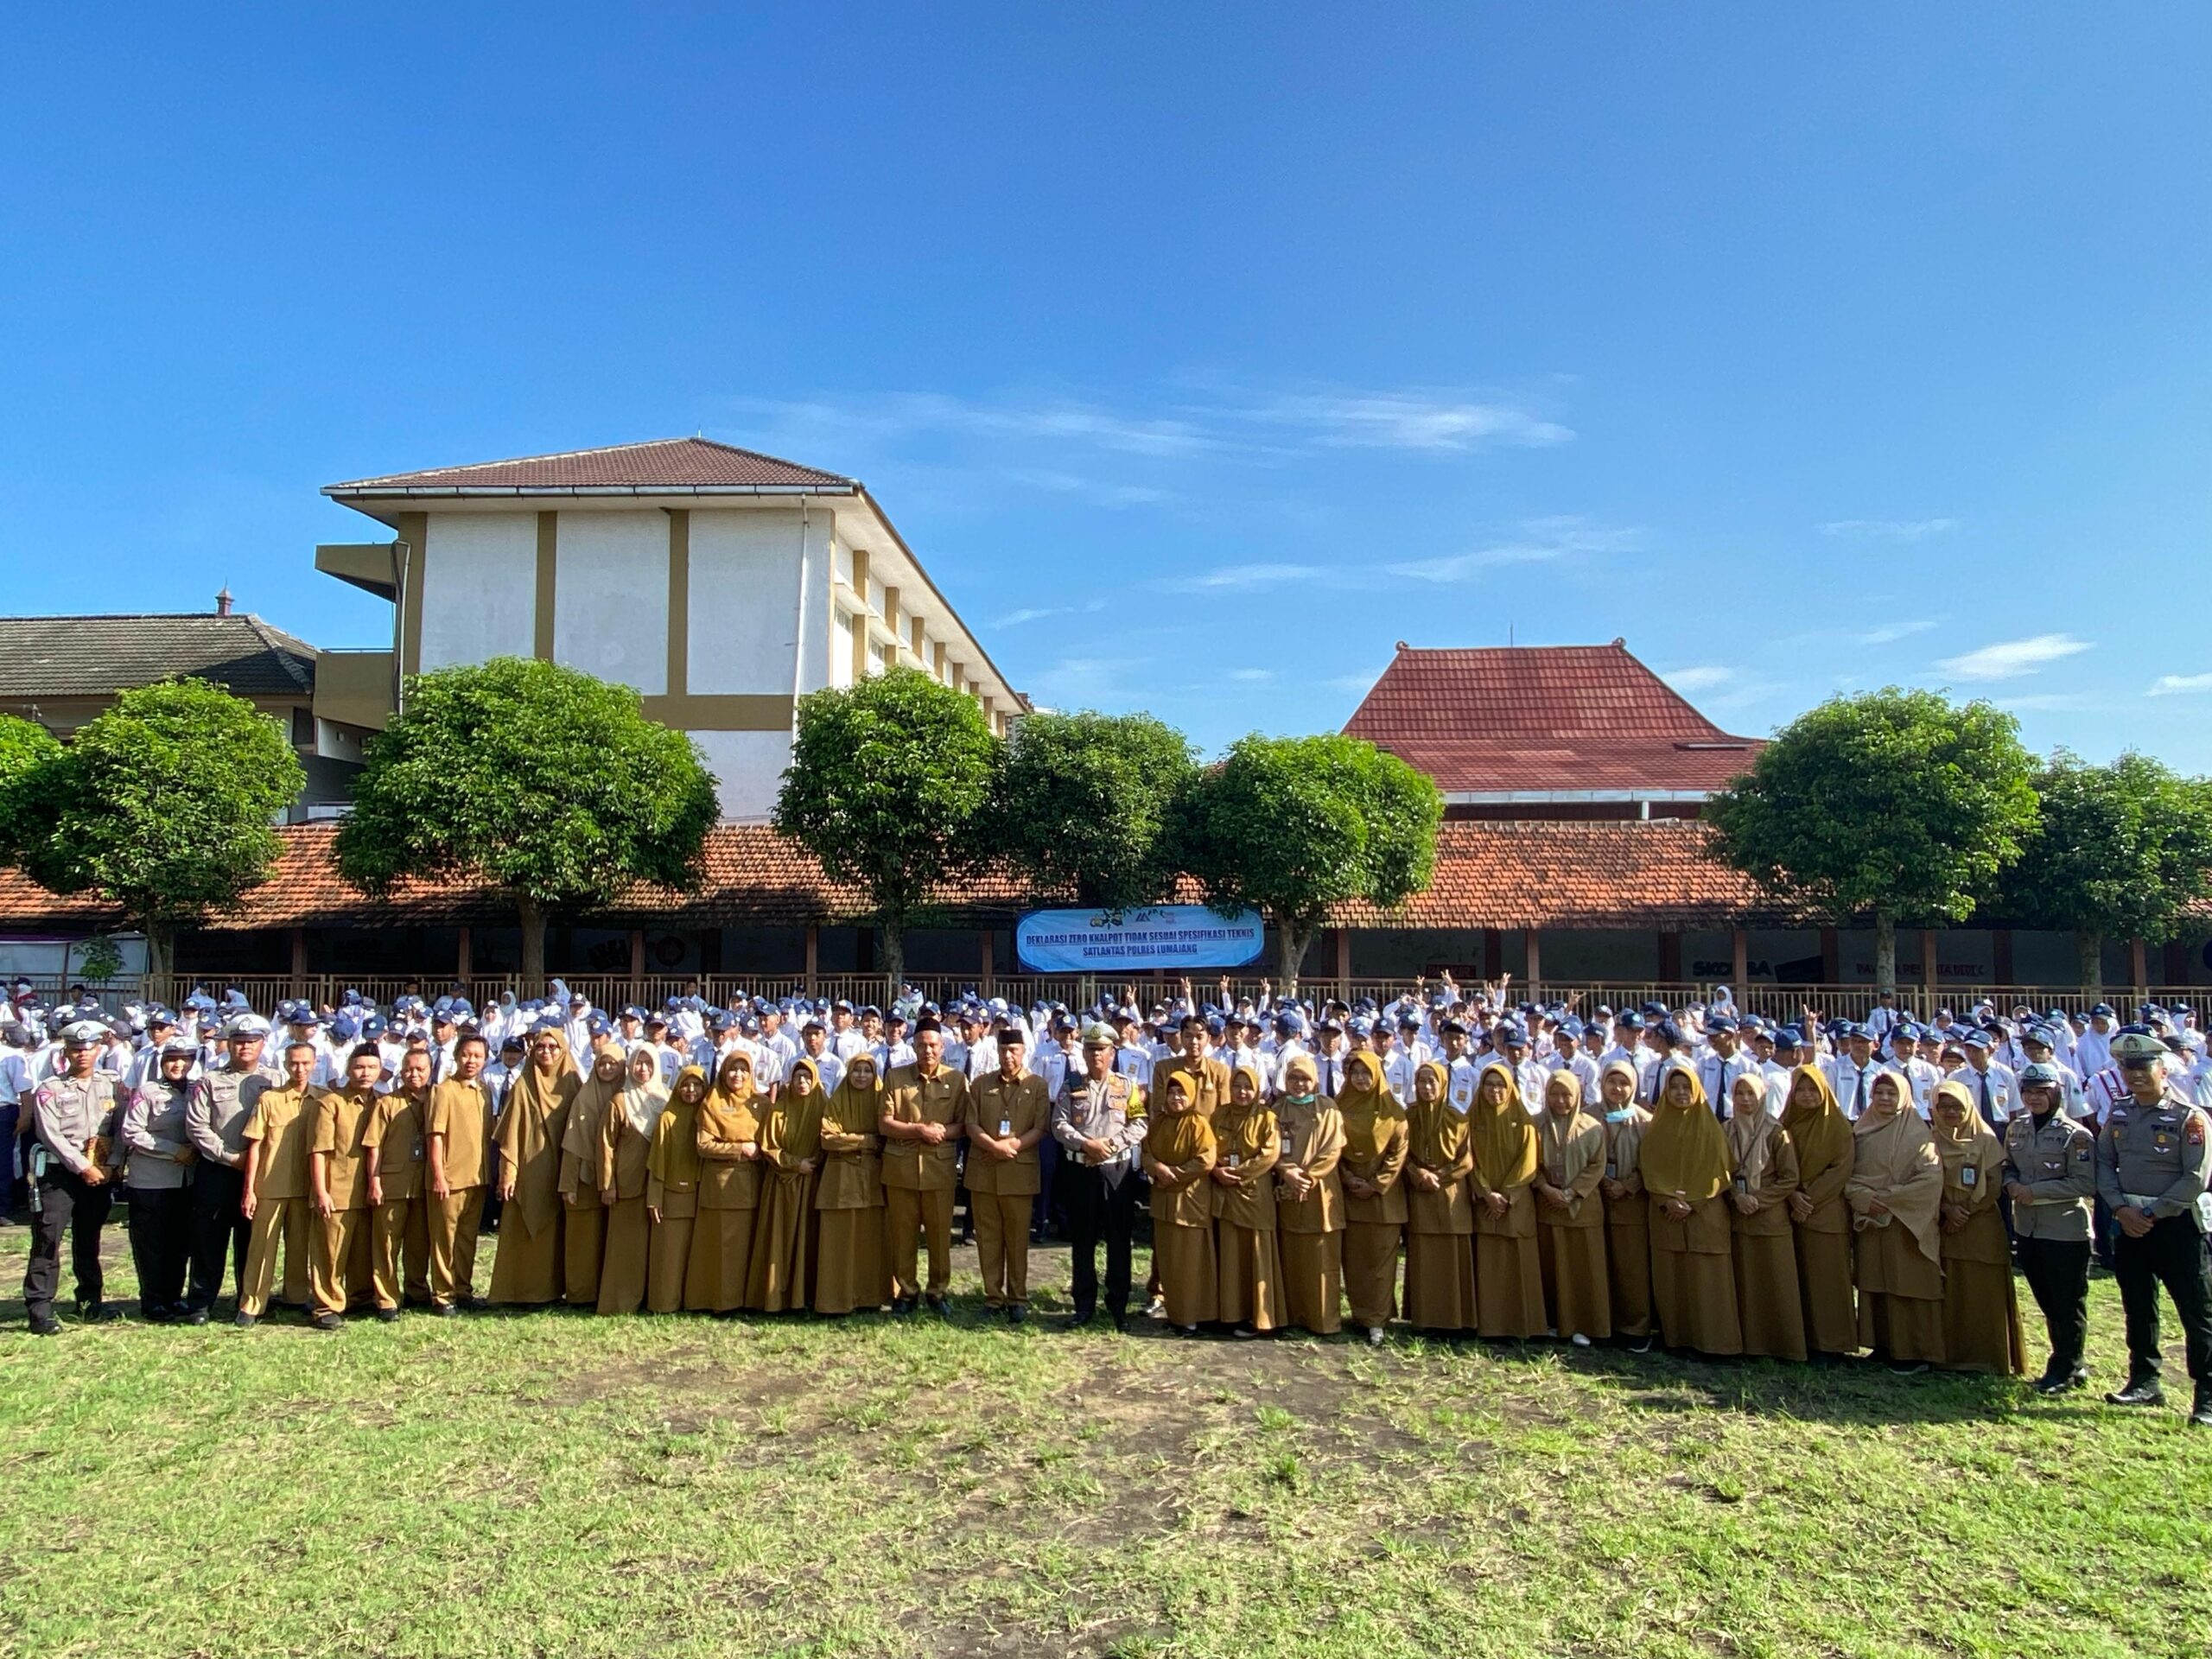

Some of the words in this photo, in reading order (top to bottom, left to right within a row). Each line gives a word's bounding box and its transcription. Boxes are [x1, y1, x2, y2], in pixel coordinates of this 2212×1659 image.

[1026, 934, 1068, 945] DEKLARASI
[1068, 934, 1088, 944] ZERO
[1123, 931, 1148, 942] TIDAK
[1149, 931, 1177, 941] SESUAI
[1178, 929, 1226, 940] SPESIFIKASI
[1227, 927, 1255, 938] TEKNIS
[1082, 946, 1126, 957] SATLANTAS
[1126, 944, 1156, 955] POLRES
[1157, 944, 1198, 954] LUMAJANG
